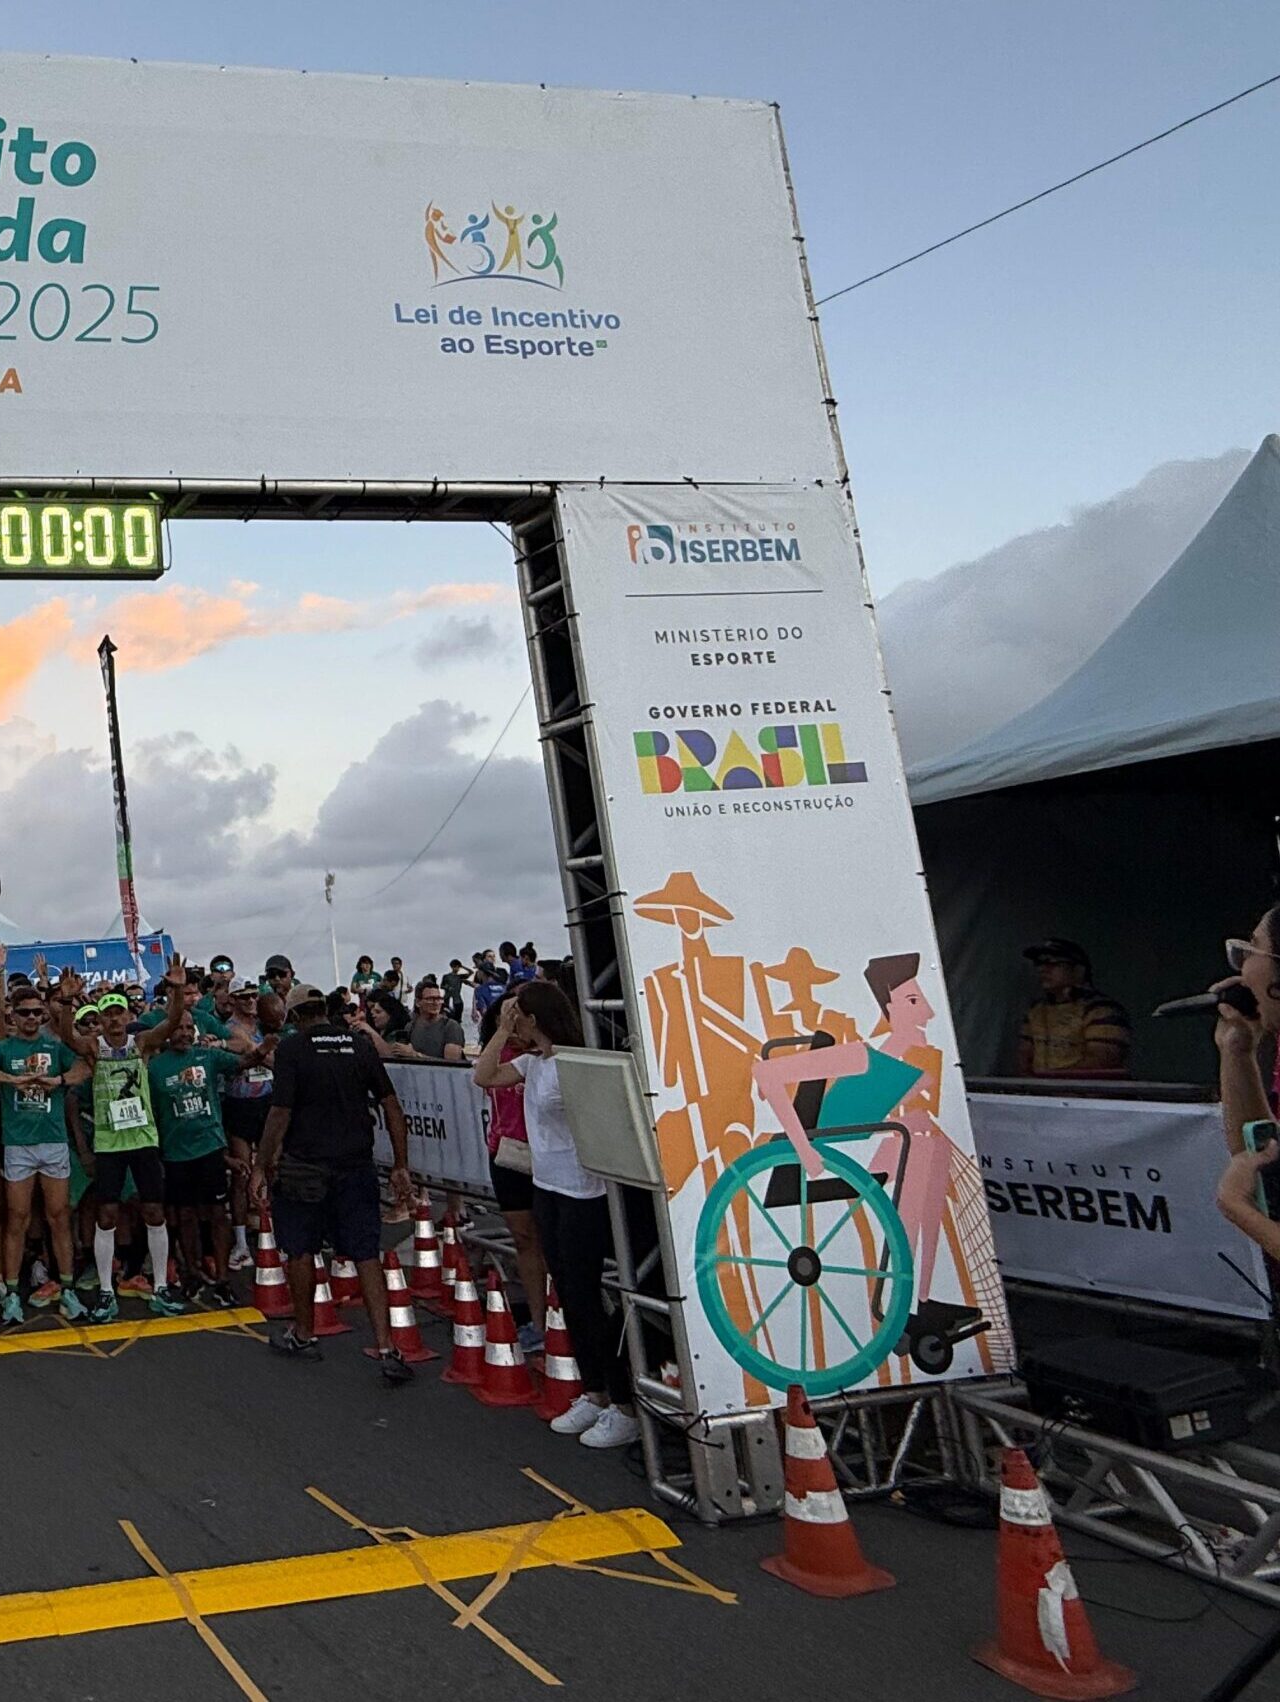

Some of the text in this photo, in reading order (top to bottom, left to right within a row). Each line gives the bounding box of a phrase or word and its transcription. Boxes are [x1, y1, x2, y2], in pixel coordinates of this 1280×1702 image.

[394, 303, 621, 330] Lei de Incentivo
[440, 334, 595, 359] ao Esporte
[677, 522, 796, 534] INSTITUTO
[680, 538, 801, 564] ISERBEM
[654, 626, 803, 644] MINISTÉRIO DO
[690, 651, 777, 666] ESPORTE
[648, 699, 837, 719] GOVERNO FEDERAL
[632, 723, 868, 795] BRASIL
[664, 796, 855, 818] UNIÃO E RECONSTRUÇÃO
[981, 1154, 1162, 1183] NSTITUTO
[984, 1178, 1172, 1234] SERBEM
